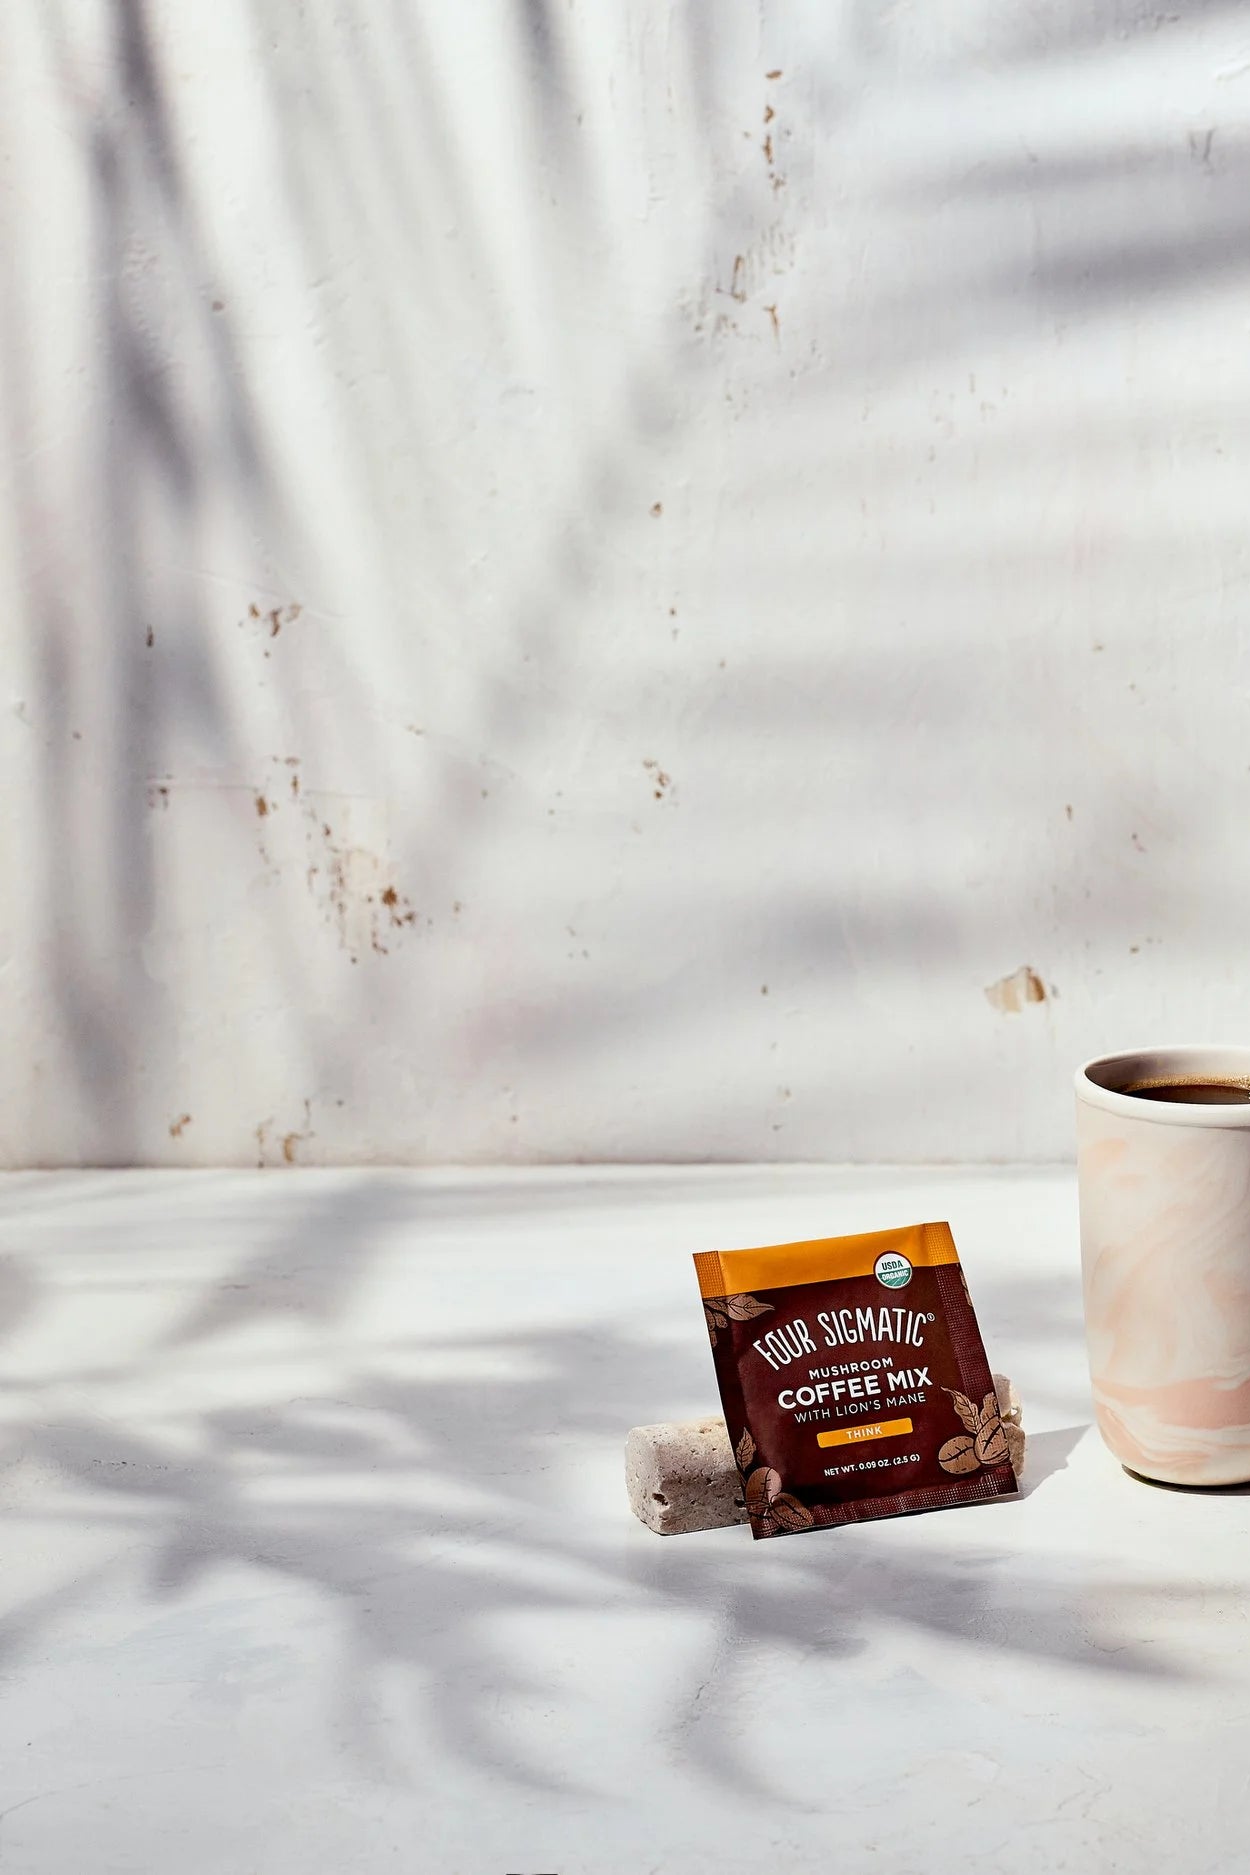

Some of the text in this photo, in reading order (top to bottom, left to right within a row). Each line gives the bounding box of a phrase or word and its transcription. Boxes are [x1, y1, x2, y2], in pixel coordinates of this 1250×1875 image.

[881, 1260, 904, 1270] USDA
[881, 1269, 909, 1280] ORGANIC
[753, 1318, 817, 1371] FOUR
[808, 1357, 894, 1380] MUSHROOM
[778, 1367, 933, 1410] COFFEE MIX
[794, 1391, 926, 1423] WITH LION'S MANE
[845, 1426, 883, 1439] THINK
[824, 1453, 920, 1477] NET WT. 0.09 OZ. (2.5 G)
